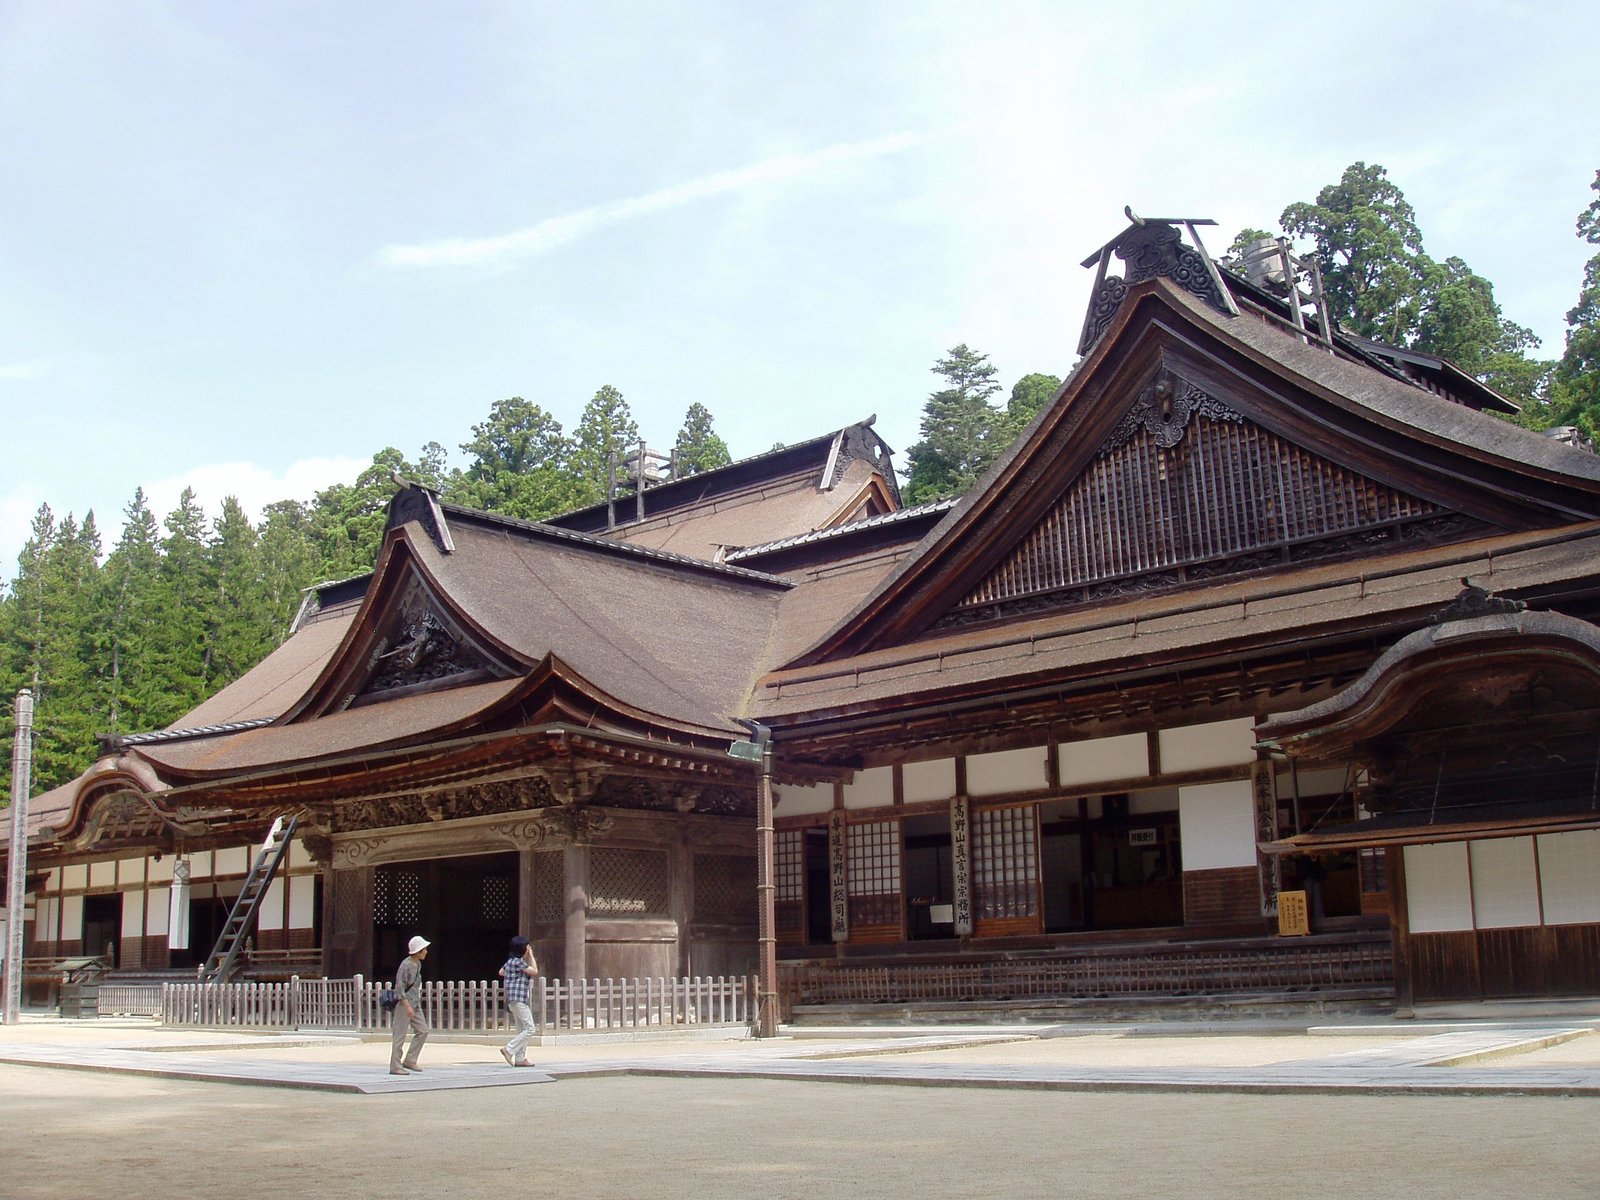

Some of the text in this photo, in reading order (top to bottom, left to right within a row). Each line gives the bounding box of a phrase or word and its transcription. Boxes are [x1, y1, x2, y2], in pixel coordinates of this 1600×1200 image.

[954, 804, 969, 925] 高野山真言宗宗務所
